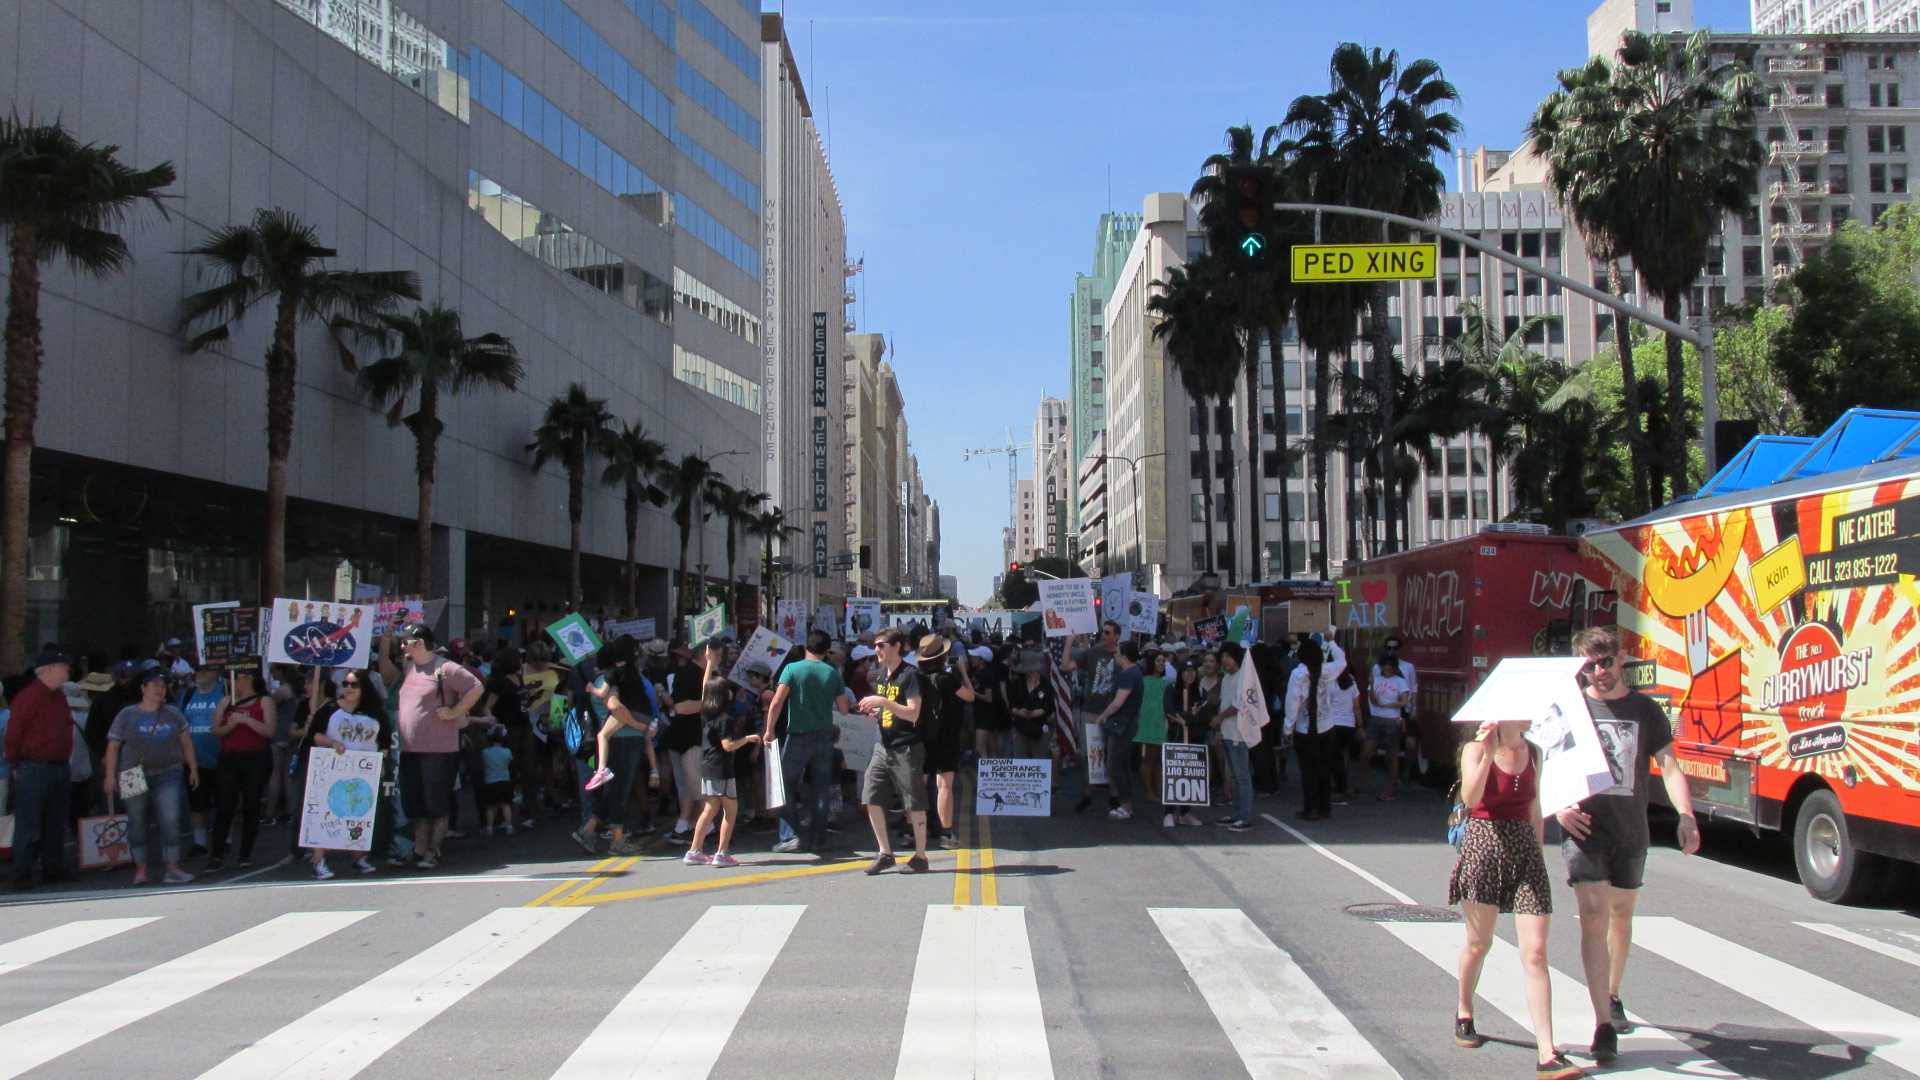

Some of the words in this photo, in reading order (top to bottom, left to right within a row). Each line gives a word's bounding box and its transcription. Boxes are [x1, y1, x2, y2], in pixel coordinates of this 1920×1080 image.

[1501, 202, 1559, 218] MAR
[765, 236, 776, 307] DIAMOND
[1304, 253, 1354, 275] PED
[1366, 251, 1425, 273] XING
[1081, 294, 1089, 314] LOS
[765, 326, 776, 399] JEWELRY
[814, 315, 826, 403] WESTERN
[1082, 368, 1091, 414] JEWELRY
[766, 403, 776, 462] CENTER
[815, 420, 826, 508] JEWELRY
[1839, 518, 1854, 546] WE
[1857, 508, 1896, 542] CATER!
[815, 524, 826, 575] MART
[1766, 565, 1790, 590] Köln
[1809, 559, 1832, 585] CALL
[1336, 580, 1353, 602] I
[1346, 602, 1388, 627] AIR
[204, 634, 234, 642] science
[288, 634, 354, 650] NASA
[1795, 643, 1809, 661] THE
[1760, 646, 1873, 711] CURRYWURST
[1799, 736, 1812, 750] Los
[1812, 732, 1843, 749] Angeles
[1166, 767, 1181, 775] OUT
[1184, 767, 1206, 776] DRIVE
[1167, 778, 1206, 801] NO!
